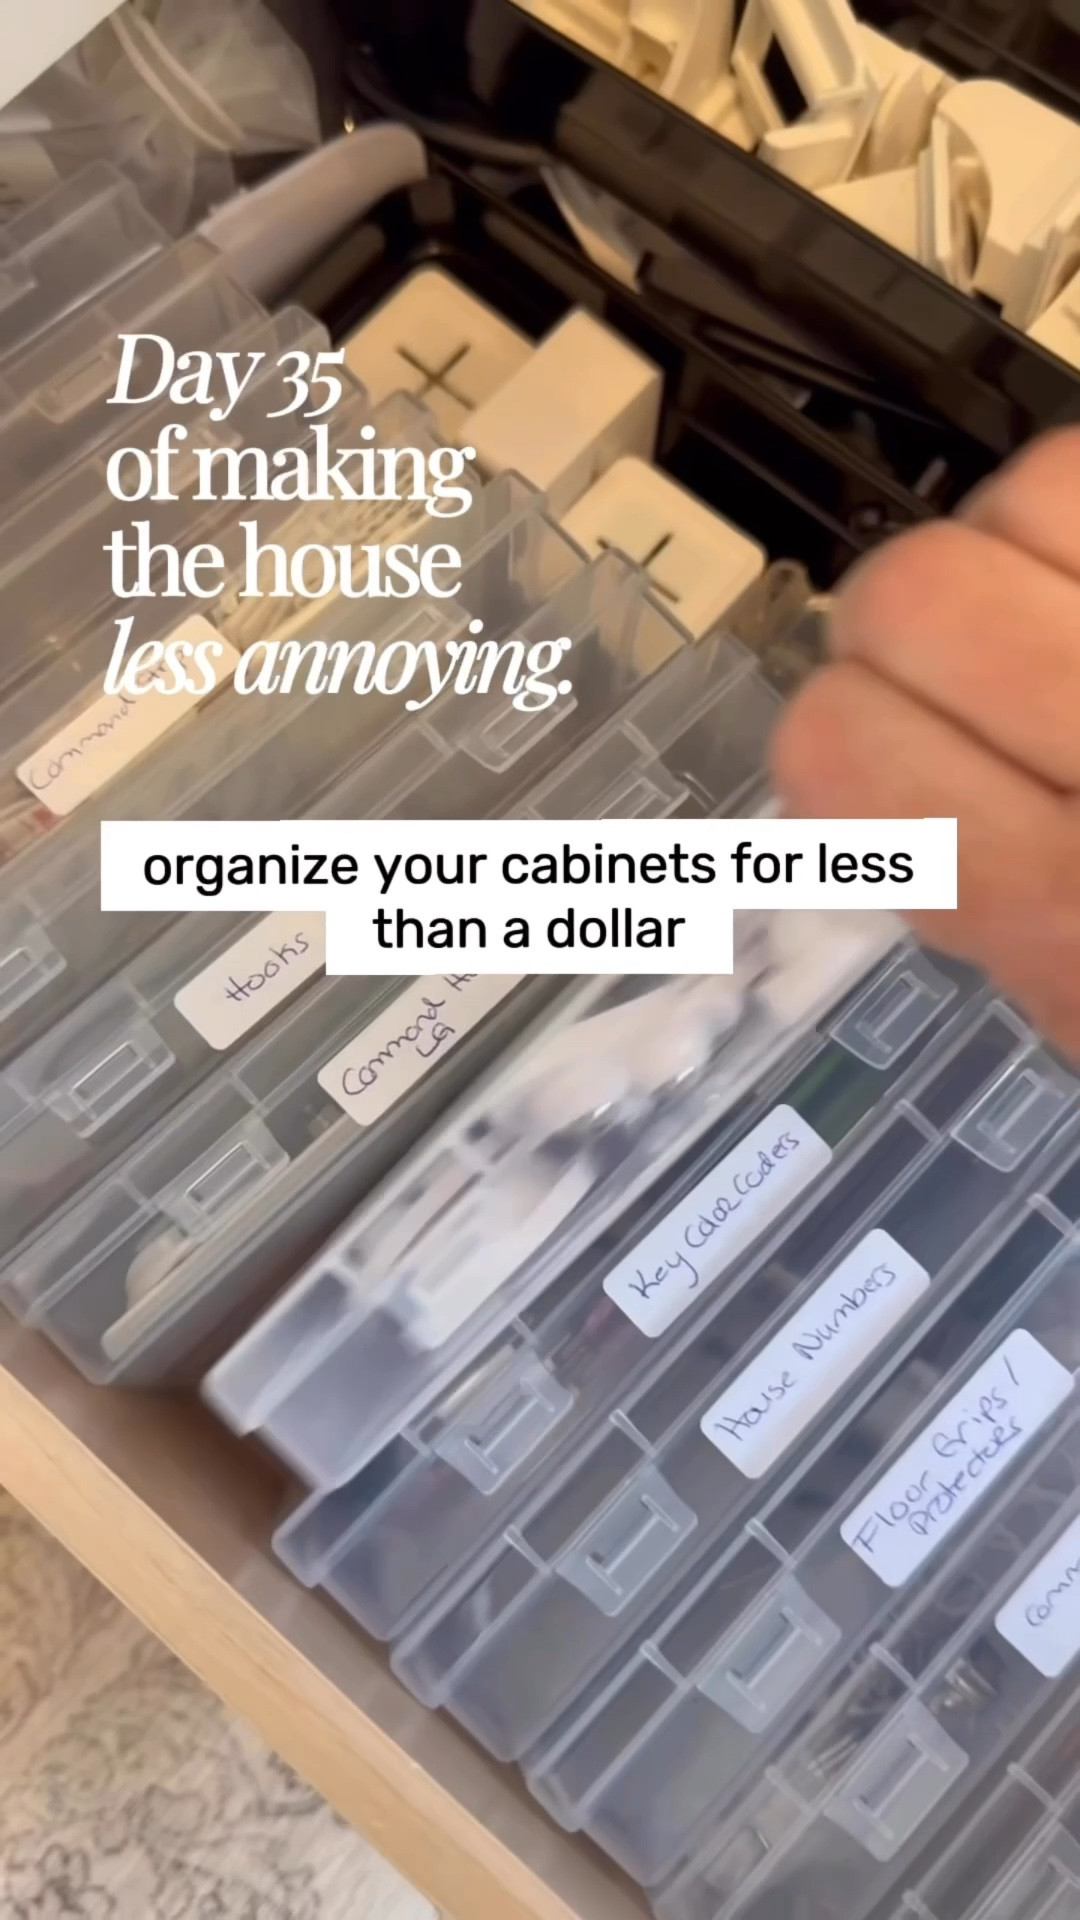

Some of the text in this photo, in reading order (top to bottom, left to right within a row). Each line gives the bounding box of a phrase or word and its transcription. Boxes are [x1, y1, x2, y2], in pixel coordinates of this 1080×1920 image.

[225, 931, 310, 1002] Hooks
[342, 996, 446, 1096] Command
[628, 1251, 699, 1299] Key
[714, 1262, 897, 1442] House Numbers
[852, 1470, 929, 1553] Floor
